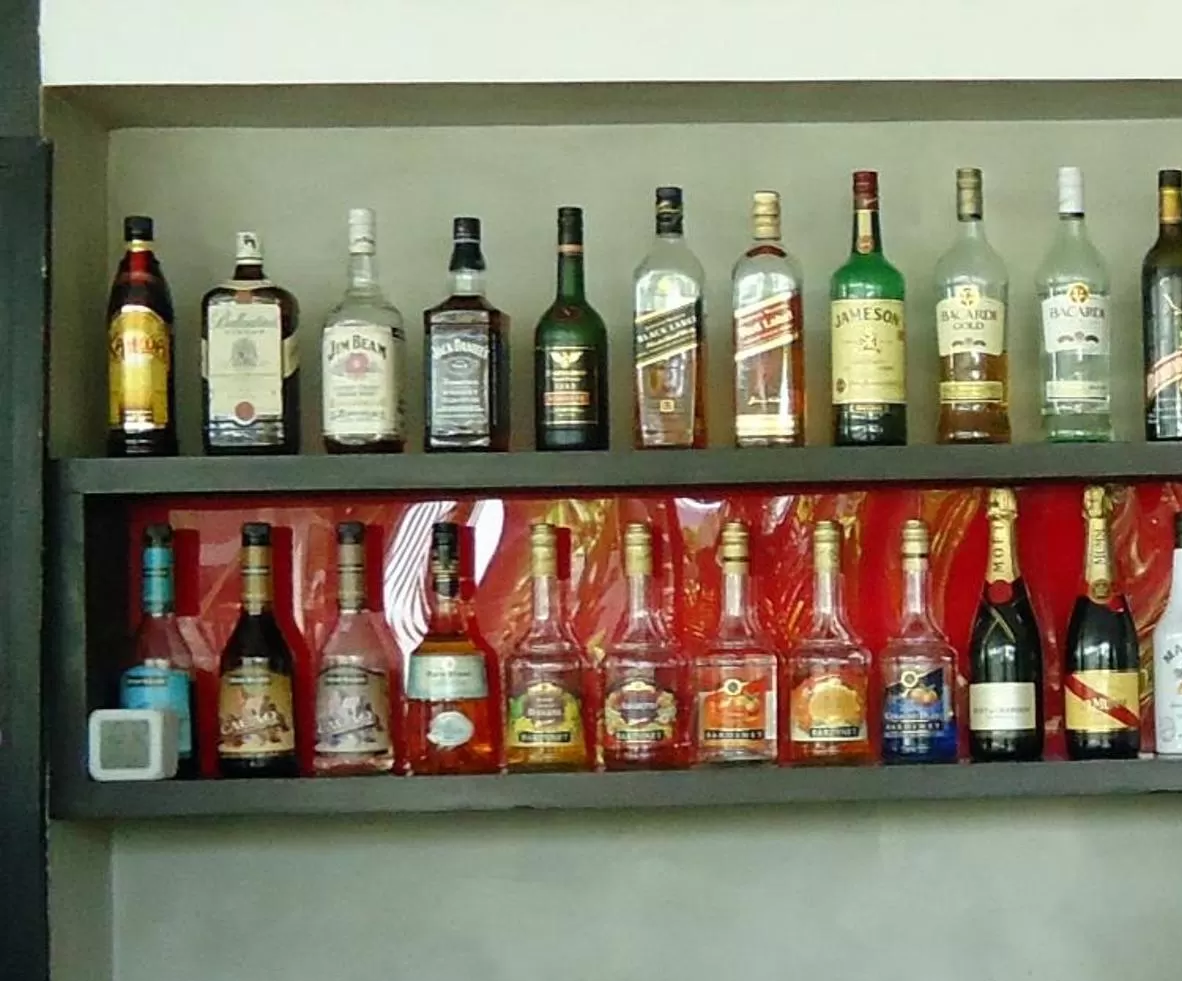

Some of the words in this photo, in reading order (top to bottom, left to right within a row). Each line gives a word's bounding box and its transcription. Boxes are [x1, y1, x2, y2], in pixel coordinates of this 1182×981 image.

[834, 306, 900, 329] JAMESON
[941, 309, 998, 322] BACARDI
[1049, 307, 1106, 319] BACARDI
[352, 334, 387, 360] BEAM
